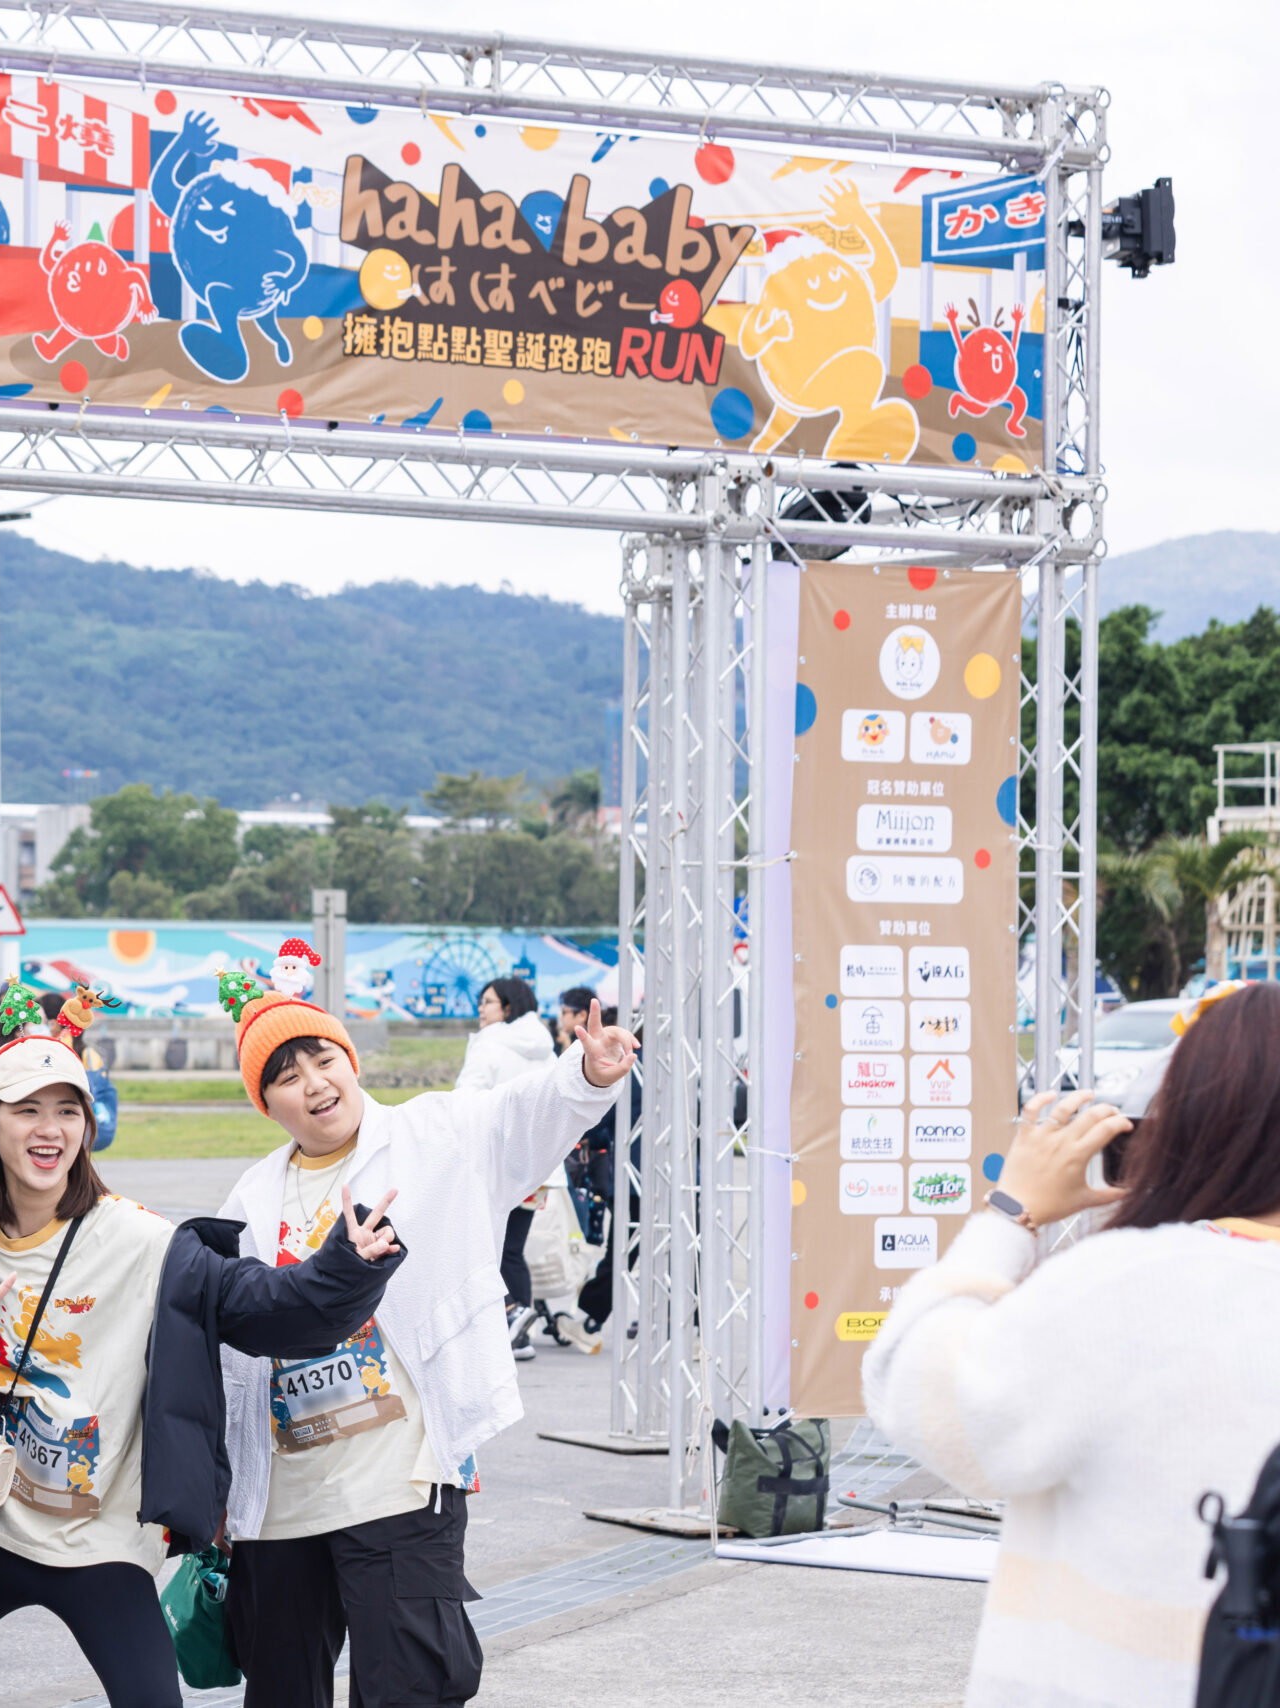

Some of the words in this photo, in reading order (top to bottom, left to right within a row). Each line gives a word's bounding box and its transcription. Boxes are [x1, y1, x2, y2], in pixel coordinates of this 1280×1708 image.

[944, 191, 1046, 240] かき
[340, 154, 532, 254] haha
[563, 174, 756, 319] baby
[343, 312, 613, 376] 擁抱點點聖誕路跑
[616, 327, 724, 385] RUN
[885, 603, 937, 621] 主辦單位
[848, 1080, 895, 1089] LONGKOW
[898, 1233, 930, 1246] AQUA
[286, 1360, 353, 1397] 41370
[19, 1427, 62, 1468] 41367
